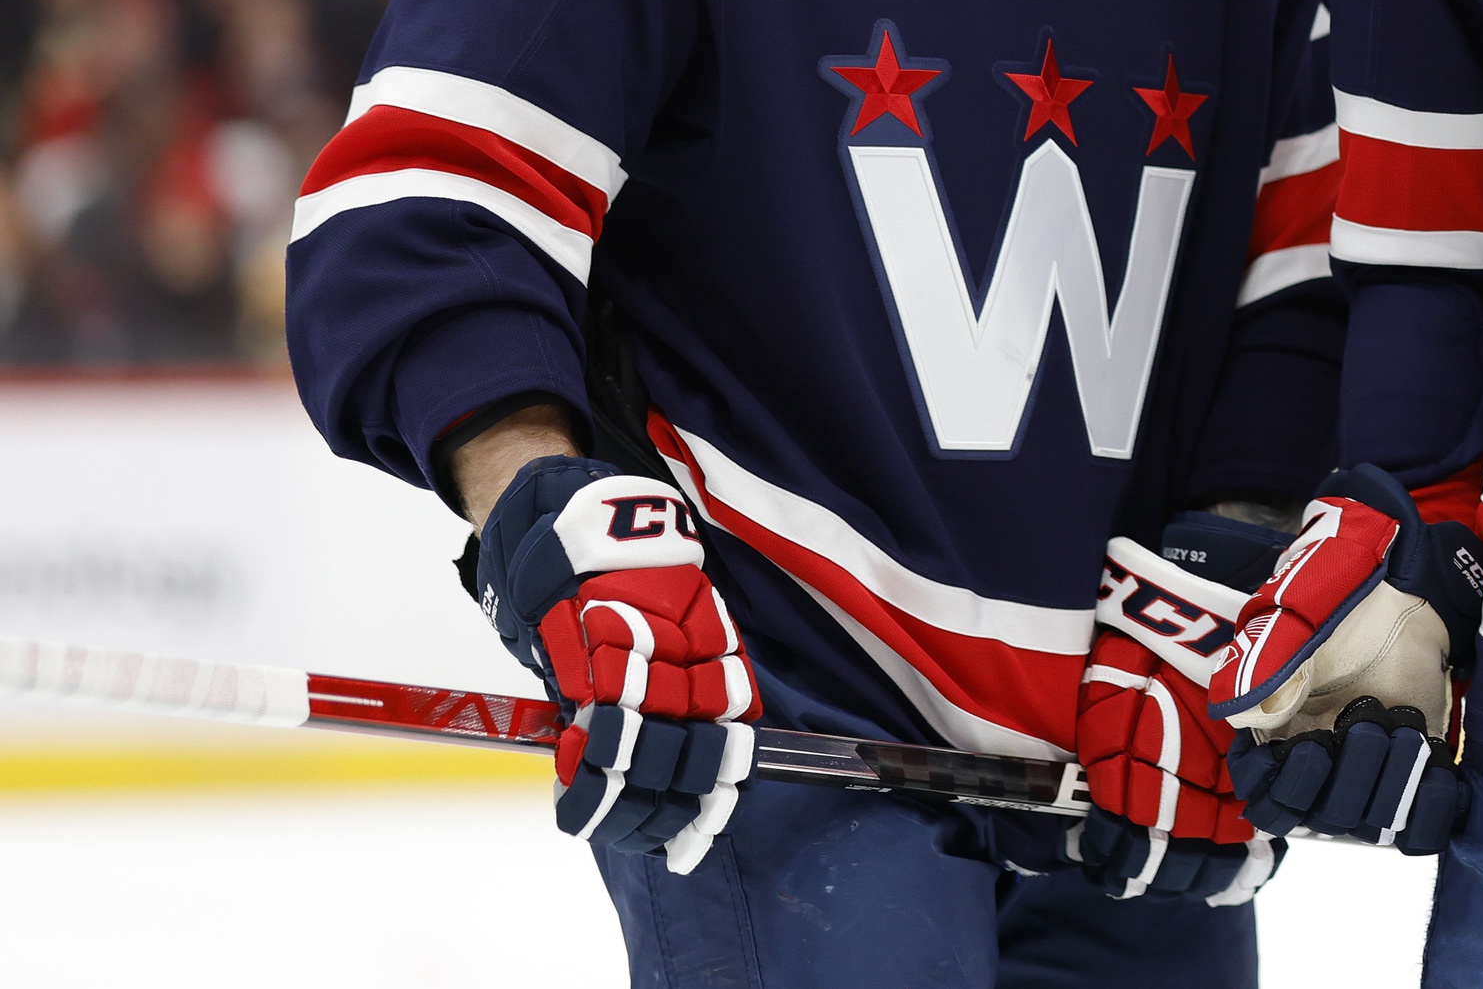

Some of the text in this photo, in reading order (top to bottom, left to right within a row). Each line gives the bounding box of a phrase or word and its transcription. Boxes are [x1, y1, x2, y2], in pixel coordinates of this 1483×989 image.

[848, 138, 1196, 460] W
[1190, 550, 1207, 563] 92
[1462, 570, 1479, 589] PRO
